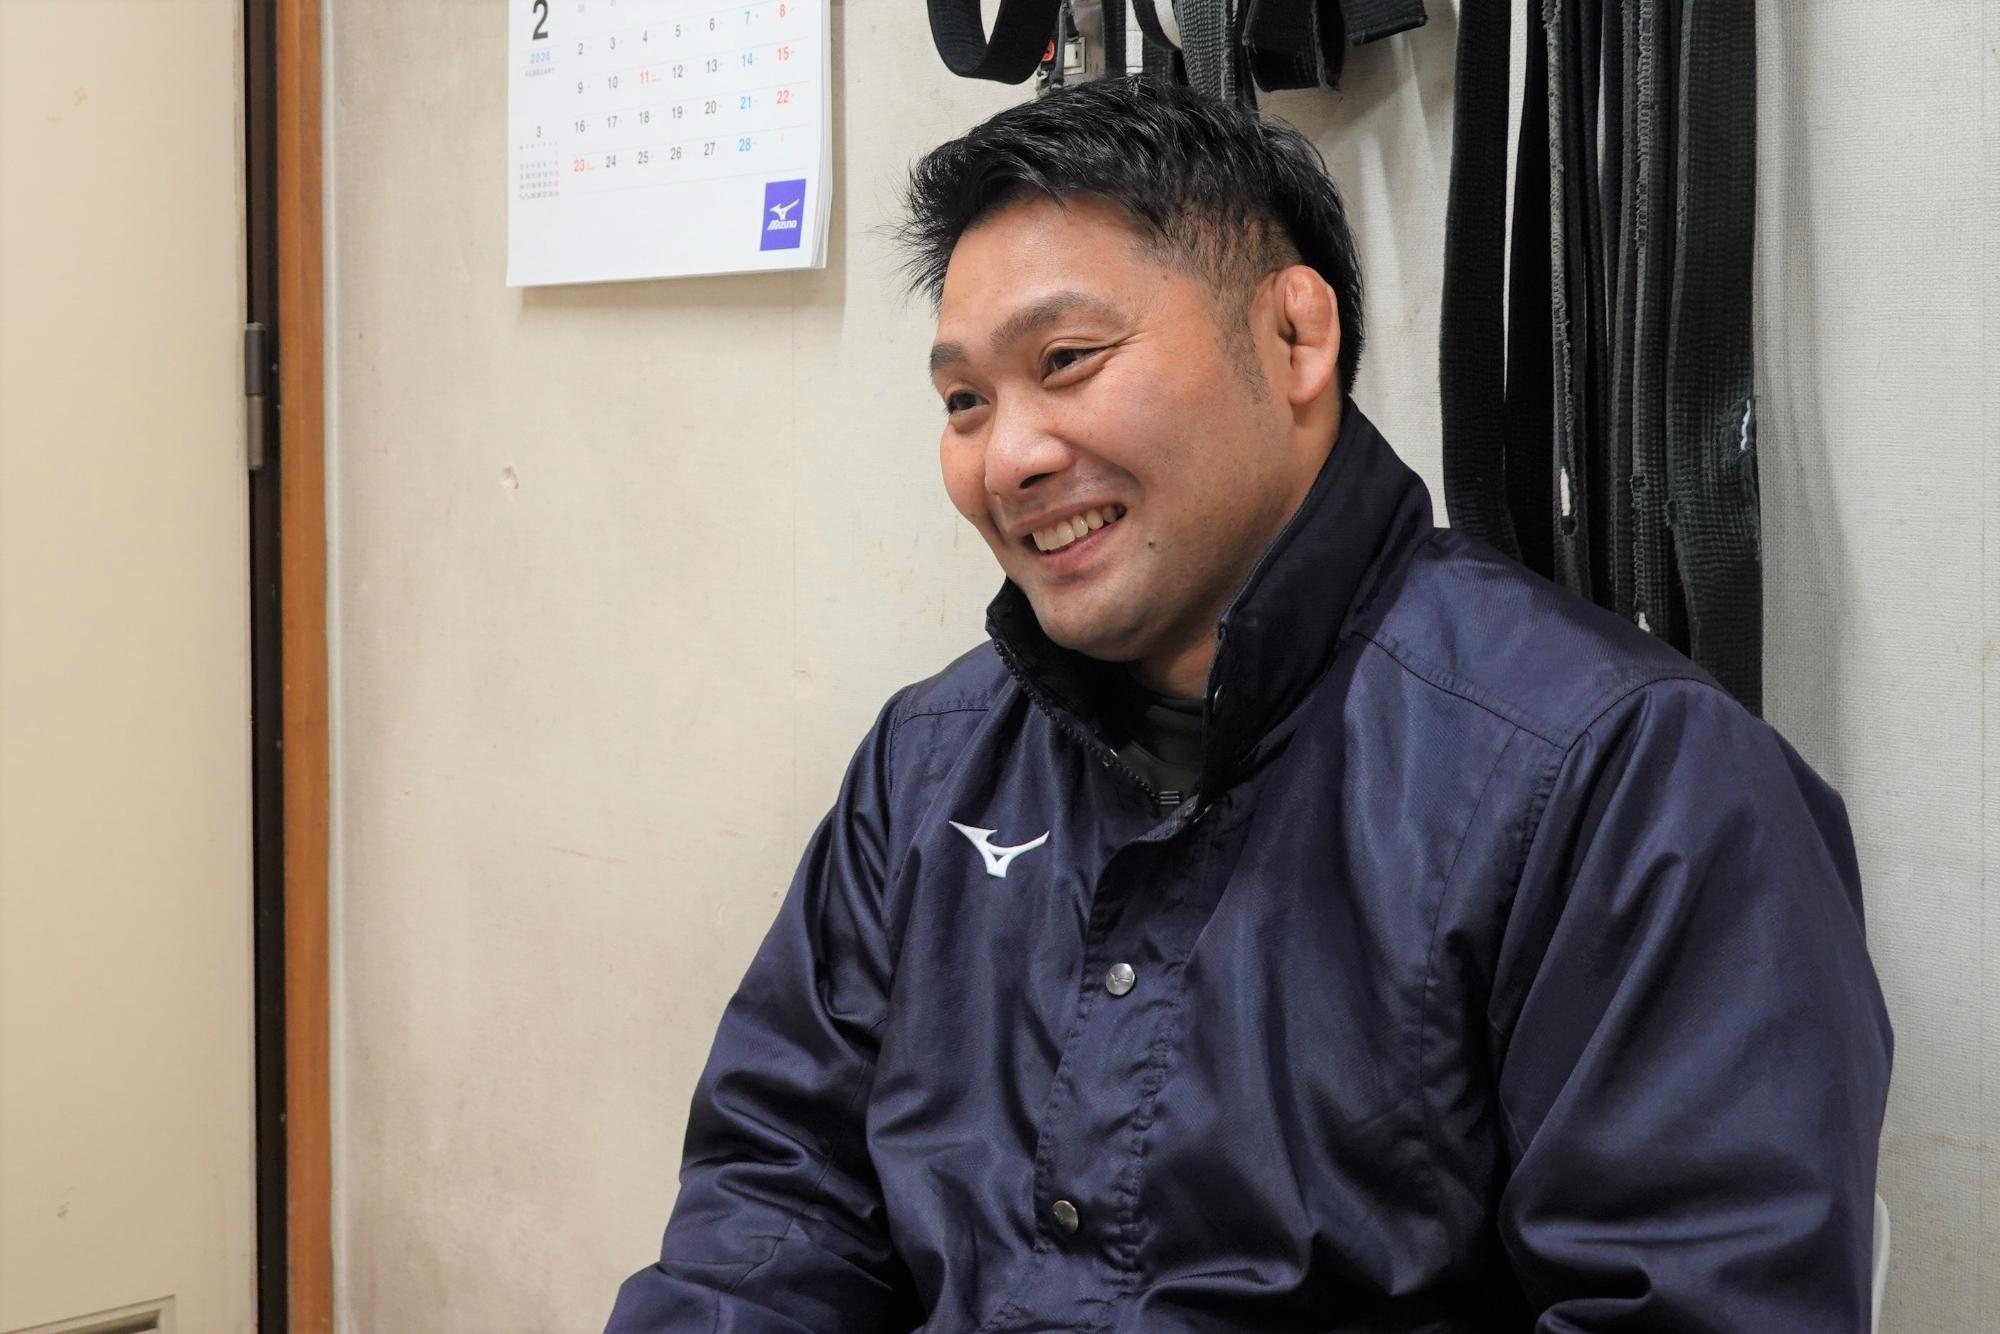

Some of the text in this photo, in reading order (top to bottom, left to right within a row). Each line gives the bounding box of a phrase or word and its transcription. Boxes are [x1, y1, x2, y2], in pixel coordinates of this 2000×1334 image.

[533, 0, 548, 40] 2
[577, 4, 786, 55] 2 3 4 5 6 7 8
[577, 82, 584, 94] 9
[607, 76, 619, 88] 10
[639, 71, 649, 83] 11
[672, 65, 684, 78] 12
[706, 59, 718, 72] 13
[741, 53, 754, 66] 14
[777, 47, 790, 60] 15
[574, 90, 790, 132] 16 17 18 19 20 21 22
[536, 126, 542, 138] 3
[573, 160, 586, 172] 23
[605, 155, 617, 168] 24
[637, 151, 649, 164] 25
[670, 147, 682, 160] 26
[703, 142, 716, 156] 27
[738, 138, 752, 152] 28
